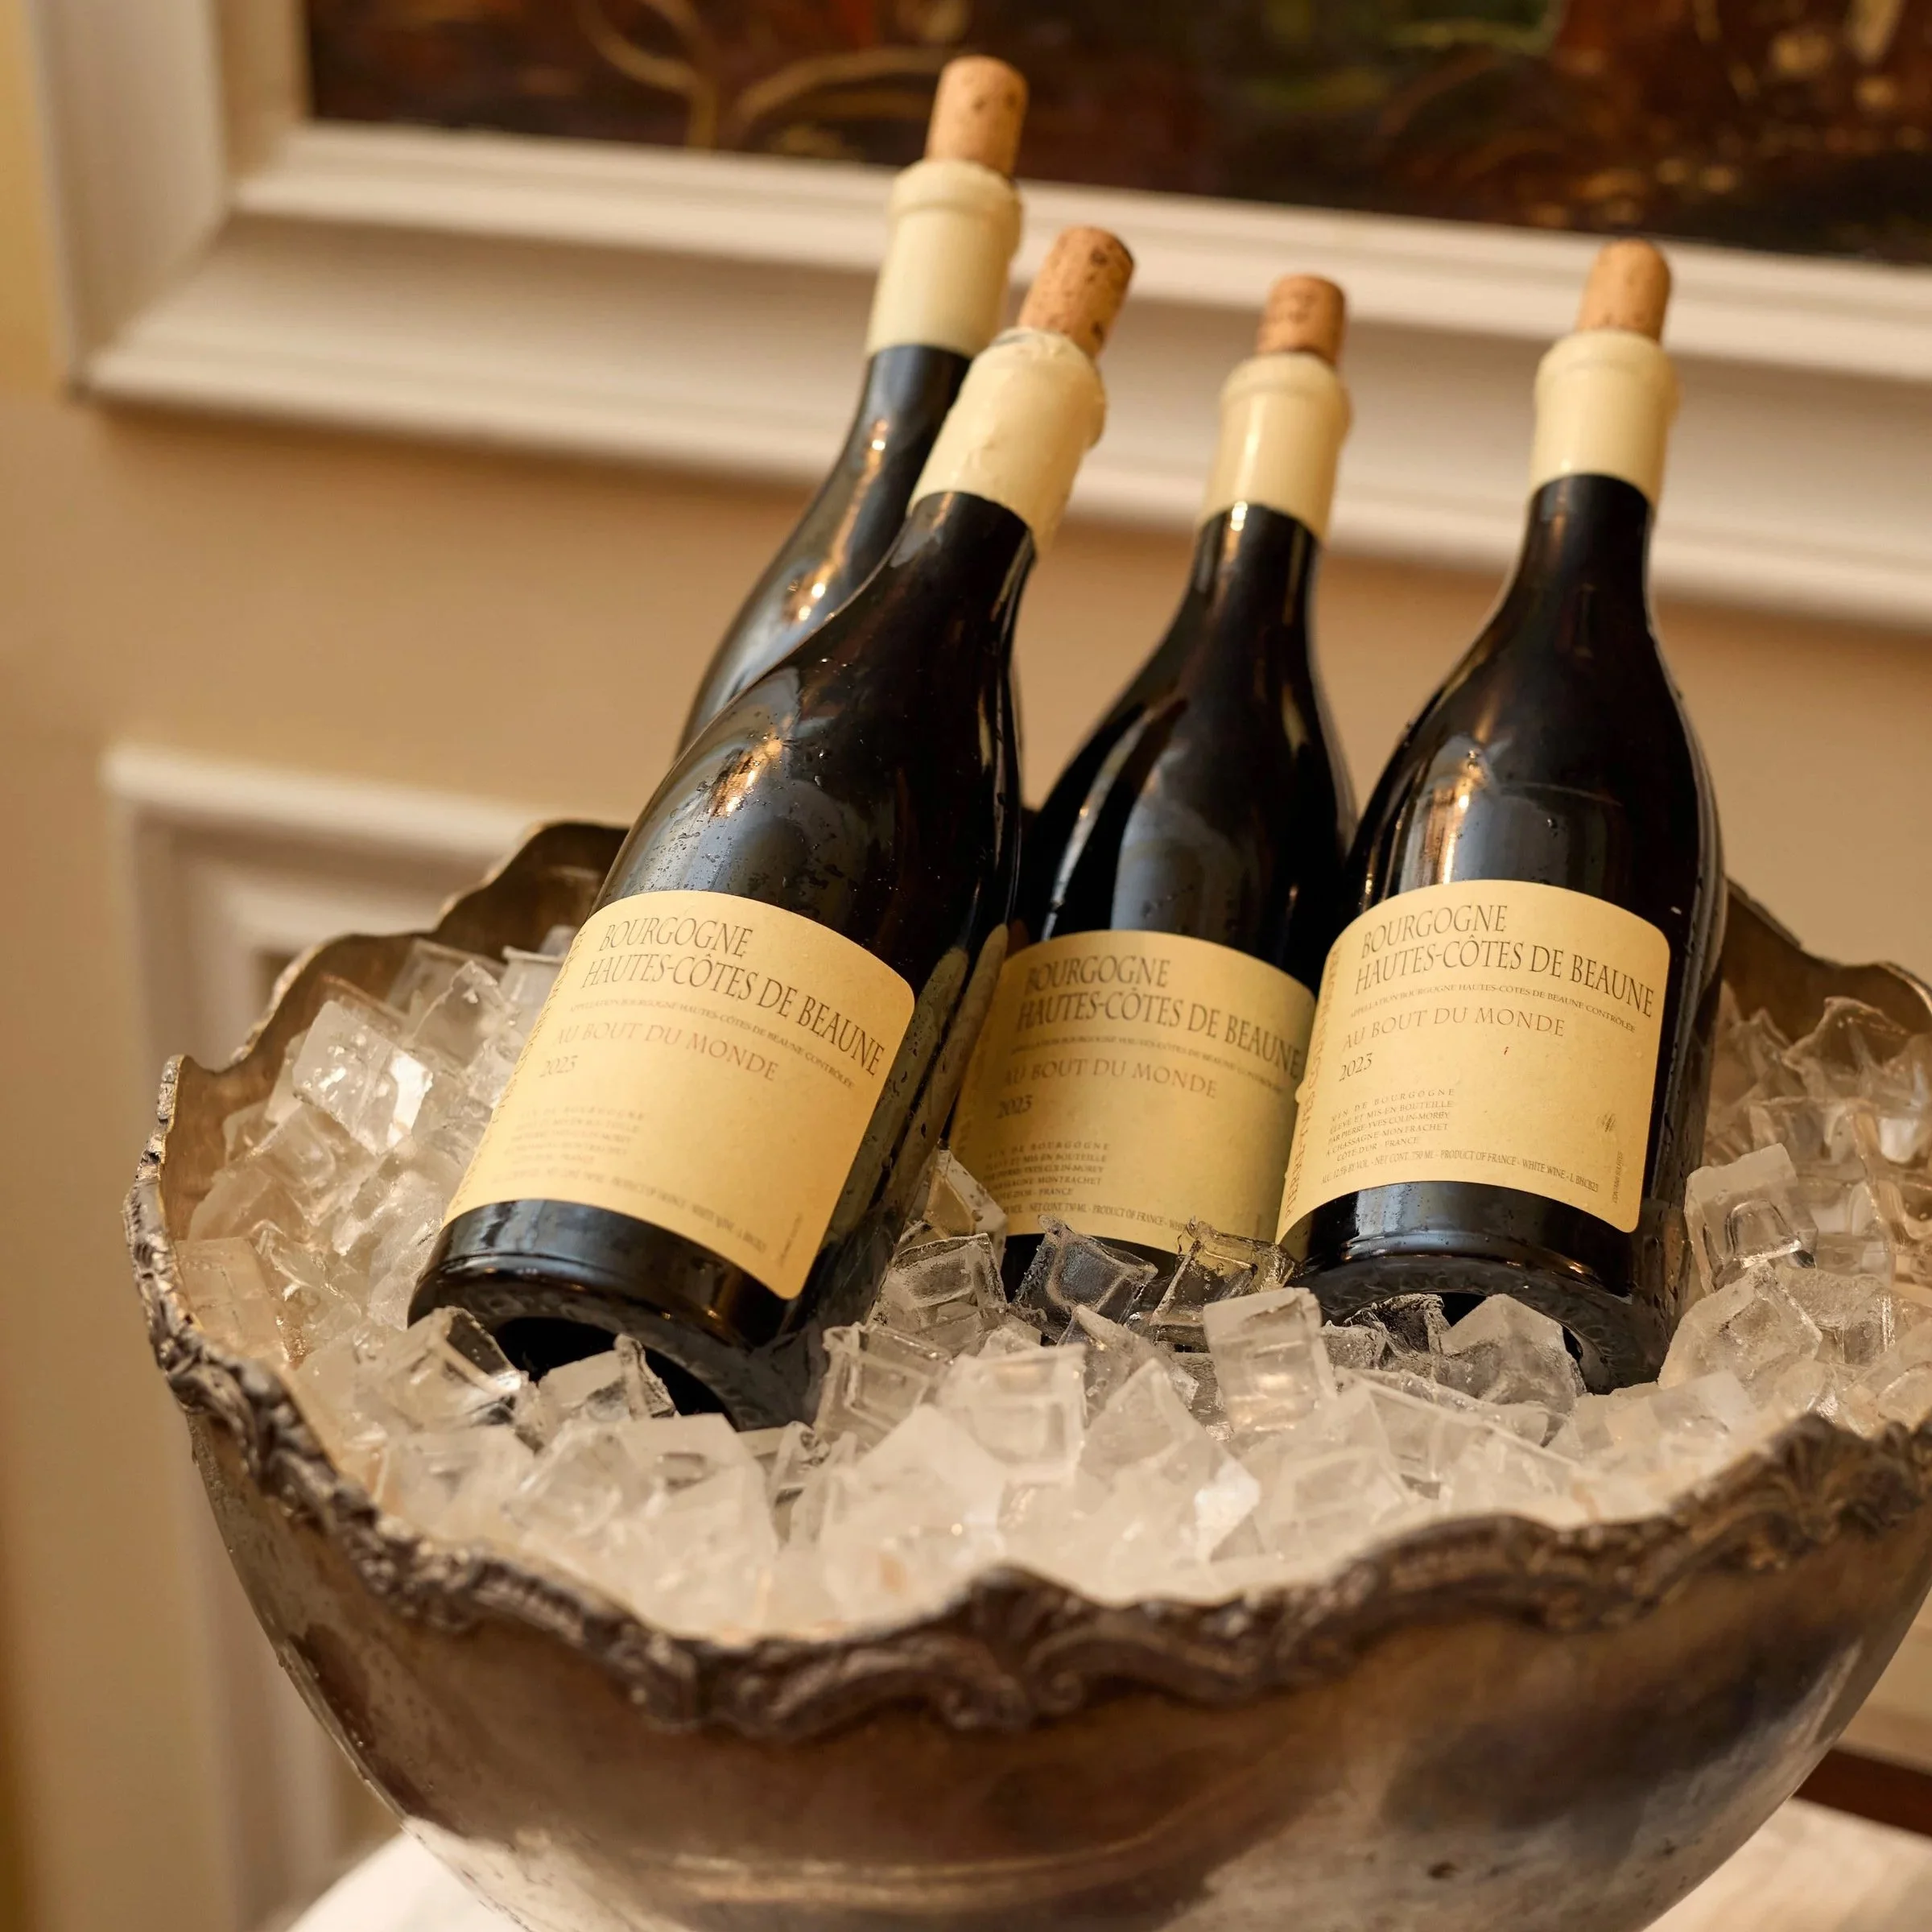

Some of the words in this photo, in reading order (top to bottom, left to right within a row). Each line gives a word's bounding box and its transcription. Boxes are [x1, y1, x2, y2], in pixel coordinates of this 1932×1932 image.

[599, 916, 753, 959] BOURGOGNE
[1361, 904, 1508, 959] BOURGOGNE
[1024, 955, 1170, 996] BOURGOGNE
[1355, 934, 1524, 996] HAUTES-CÔTES
[1529, 944, 1564, 978] DE
[1570, 954, 1654, 1018] BEAUNE
[580, 953, 759, 1001] HAUTES-CÔTES
[757, 976, 799, 1018] DE
[796, 995, 886, 1076] BEAUNE
[1532, 989, 1547, 999] DE
[1548, 993, 1584, 1009] BEAUNE
[752, 1024, 766, 1037] DE
[767, 1031, 804, 1055] BEAUNE
[1017, 987, 1183, 1032] HAUTES-CÔTES
[1187, 1002, 1220, 1038] DE
[1224, 1014, 1302, 1080] BEAUNE
[1342, 1026, 1365, 1053] AU
[1371, 1009, 1427, 1038] BOUT
[1434, 1008, 1468, 1025] DU
[1474, 1007, 1565, 1037] MONDE
[556, 1024, 580, 1045] AU
[582, 1022, 643, 1042] BOUT
[644, 1024, 683, 1046] DU
[685, 1032, 779, 1081] MONDE
[1339, 1052, 1373, 1081] 2023
[1004, 1065, 1026, 1086] AU
[1031, 1058, 1087, 1081] BOUT
[1093, 1059, 1126, 1077] DU
[1131, 1063, 1218, 1099] MONDE
[1355, 1101, 1368, 1112] DE
[1374, 1088, 1455, 1105] BOURGOGNE
[1400, 1100, 1454, 1112] BOUTEILLE
[1440, 1150, 1475, 1162] PRODUCT
[1476, 1151, 1487, 1162] OF
[1487, 1153, 1517, 1166] FRANCE
[1521, 1158, 1546, 1173] WHITE
[1546, 1165, 1566, 1179] WINE
[1126, 1208, 1137, 1219] OF
